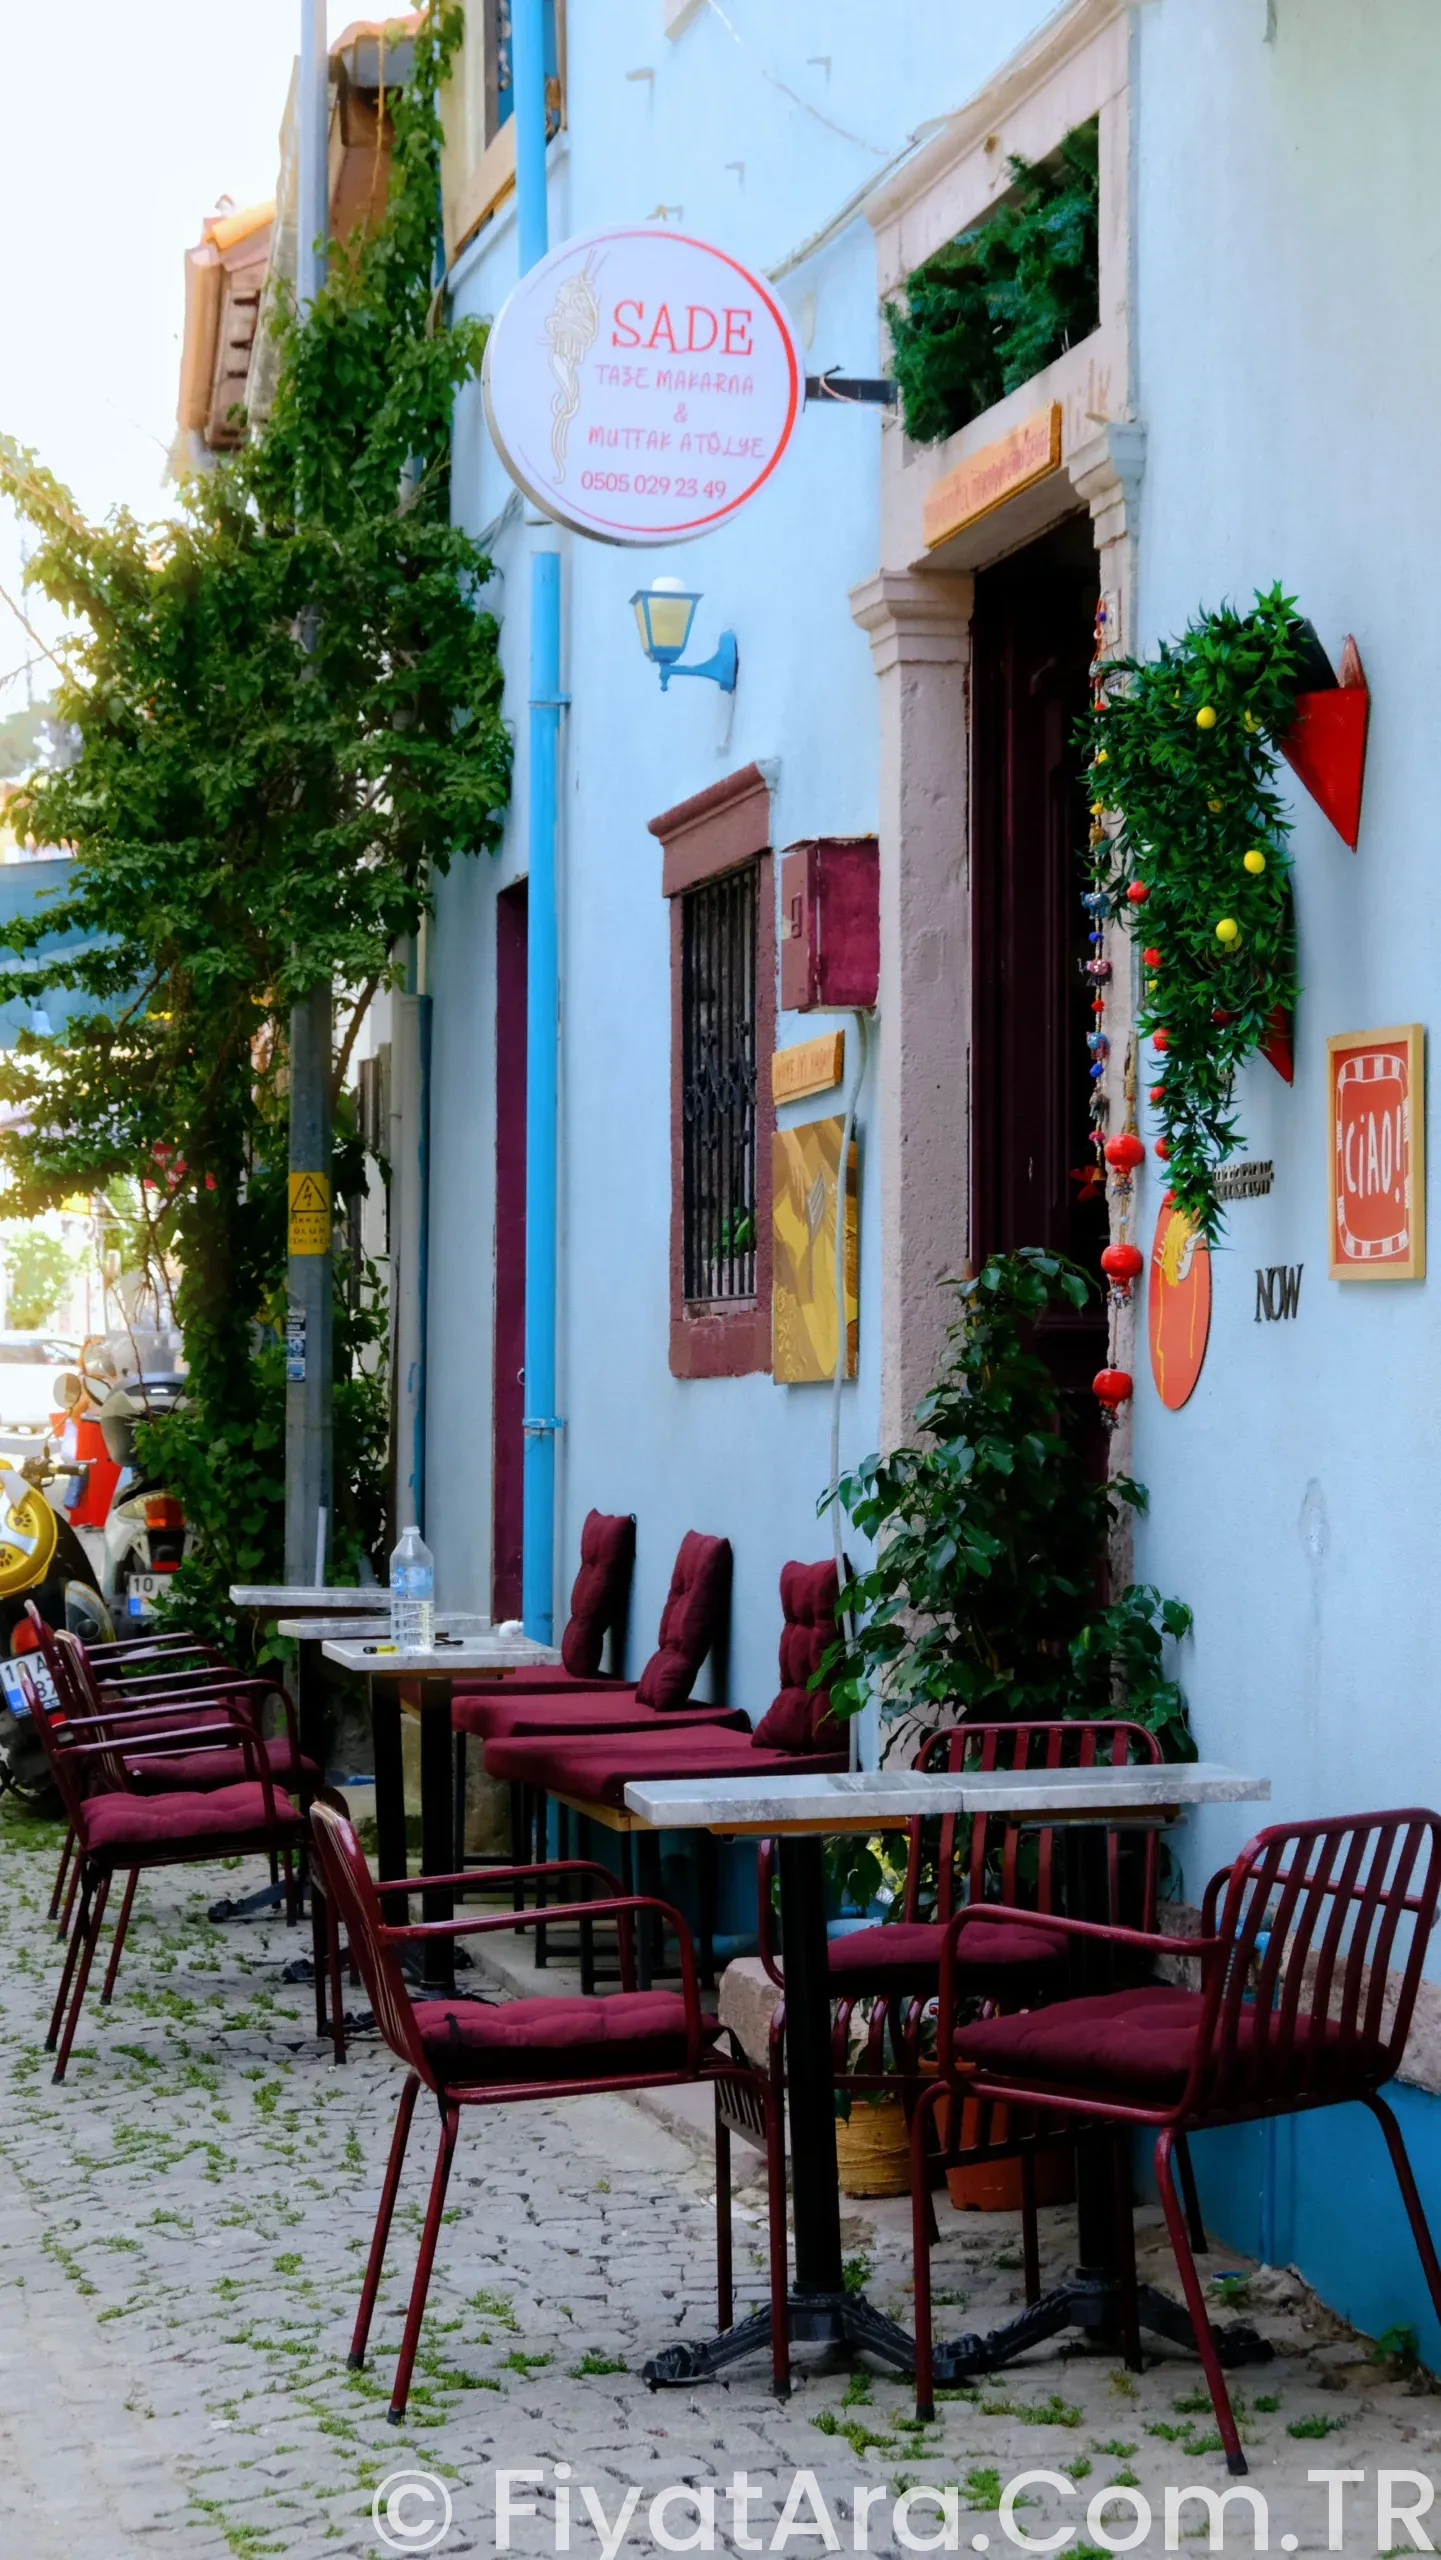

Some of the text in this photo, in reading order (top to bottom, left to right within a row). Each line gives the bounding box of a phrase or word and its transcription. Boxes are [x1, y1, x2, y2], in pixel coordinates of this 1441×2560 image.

[611, 299, 753, 355] SADE
[655, 368, 754, 396] MAKARNA
[673, 402, 688, 423] &
[581, 470, 727, 500] 0505 029 23 49
[1253, 1263, 1304, 1323] NOW
[134, 1576, 153, 1592] 10
